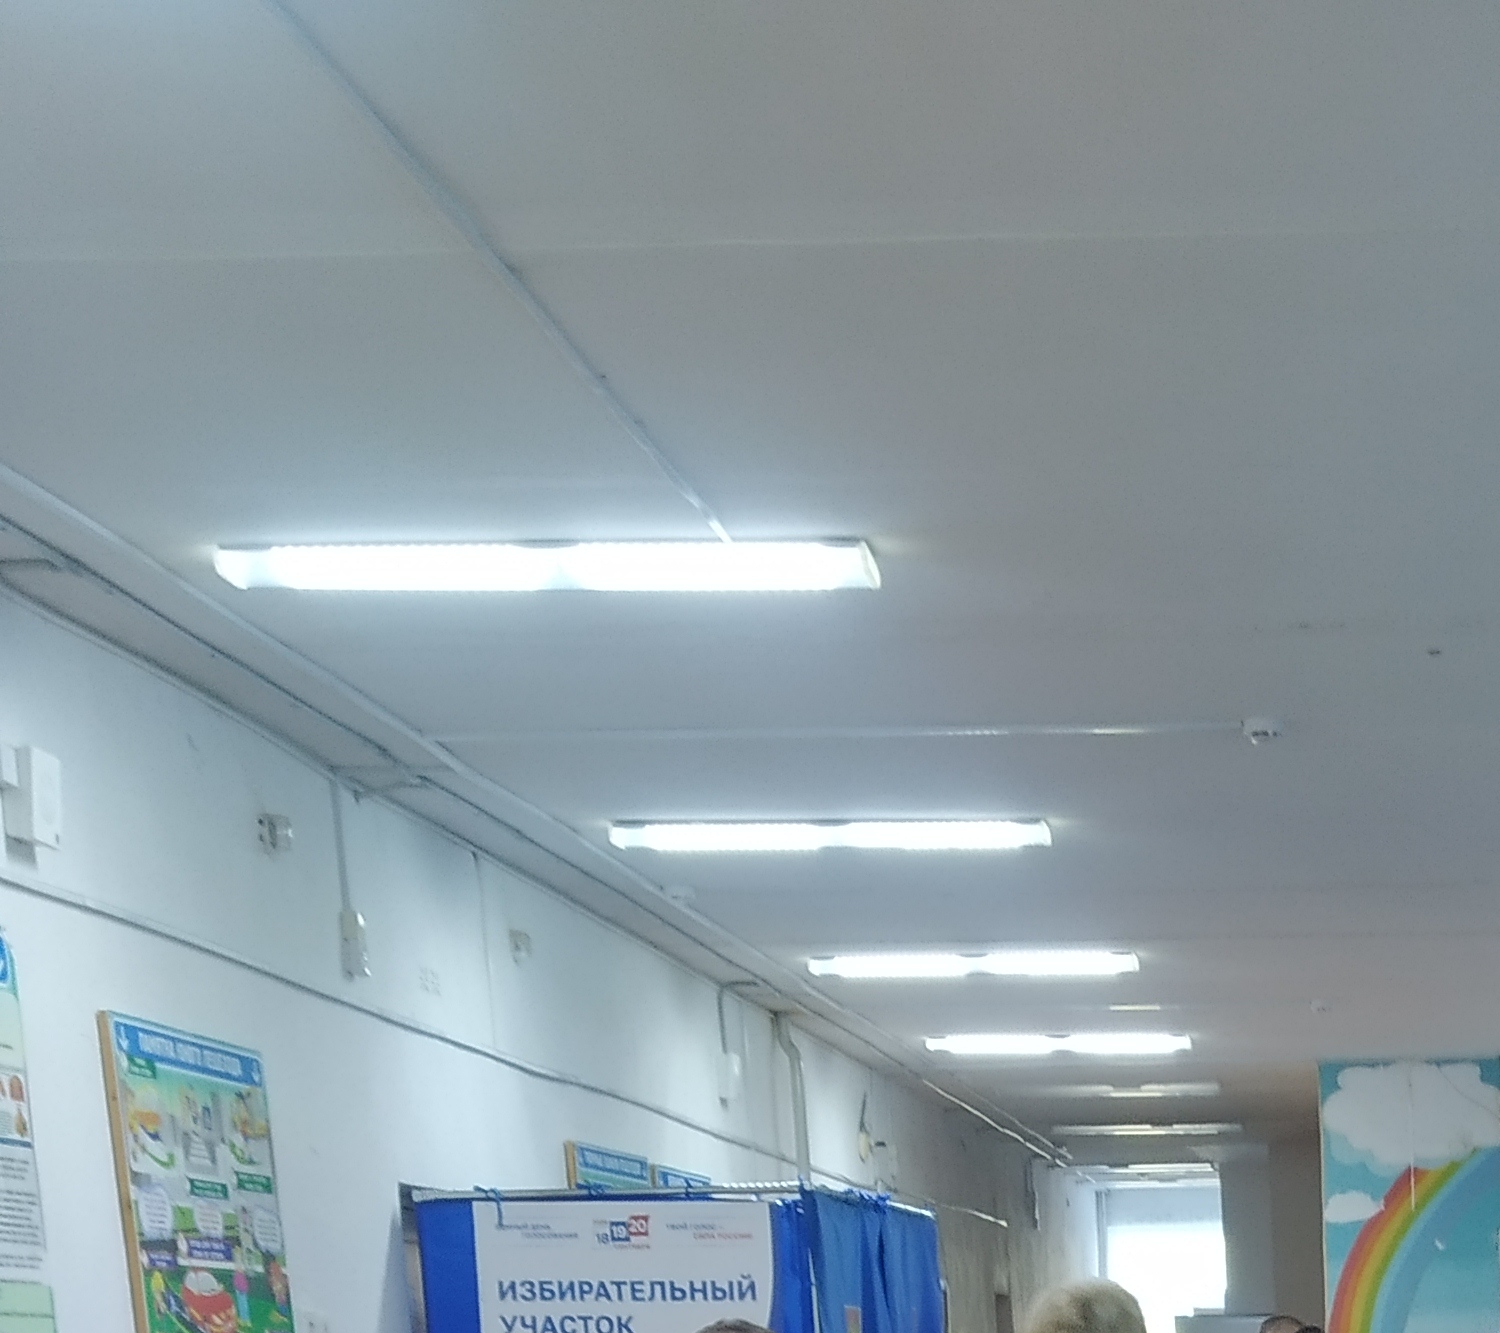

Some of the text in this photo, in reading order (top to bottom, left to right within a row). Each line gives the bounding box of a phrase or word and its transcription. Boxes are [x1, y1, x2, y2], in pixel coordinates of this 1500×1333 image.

[611, 1225, 627, 1239] 19
[628, 1218, 647, 1233] 20
[498, 1274, 757, 1302] ИЗБИРАТЕЛЬНЫЙ
